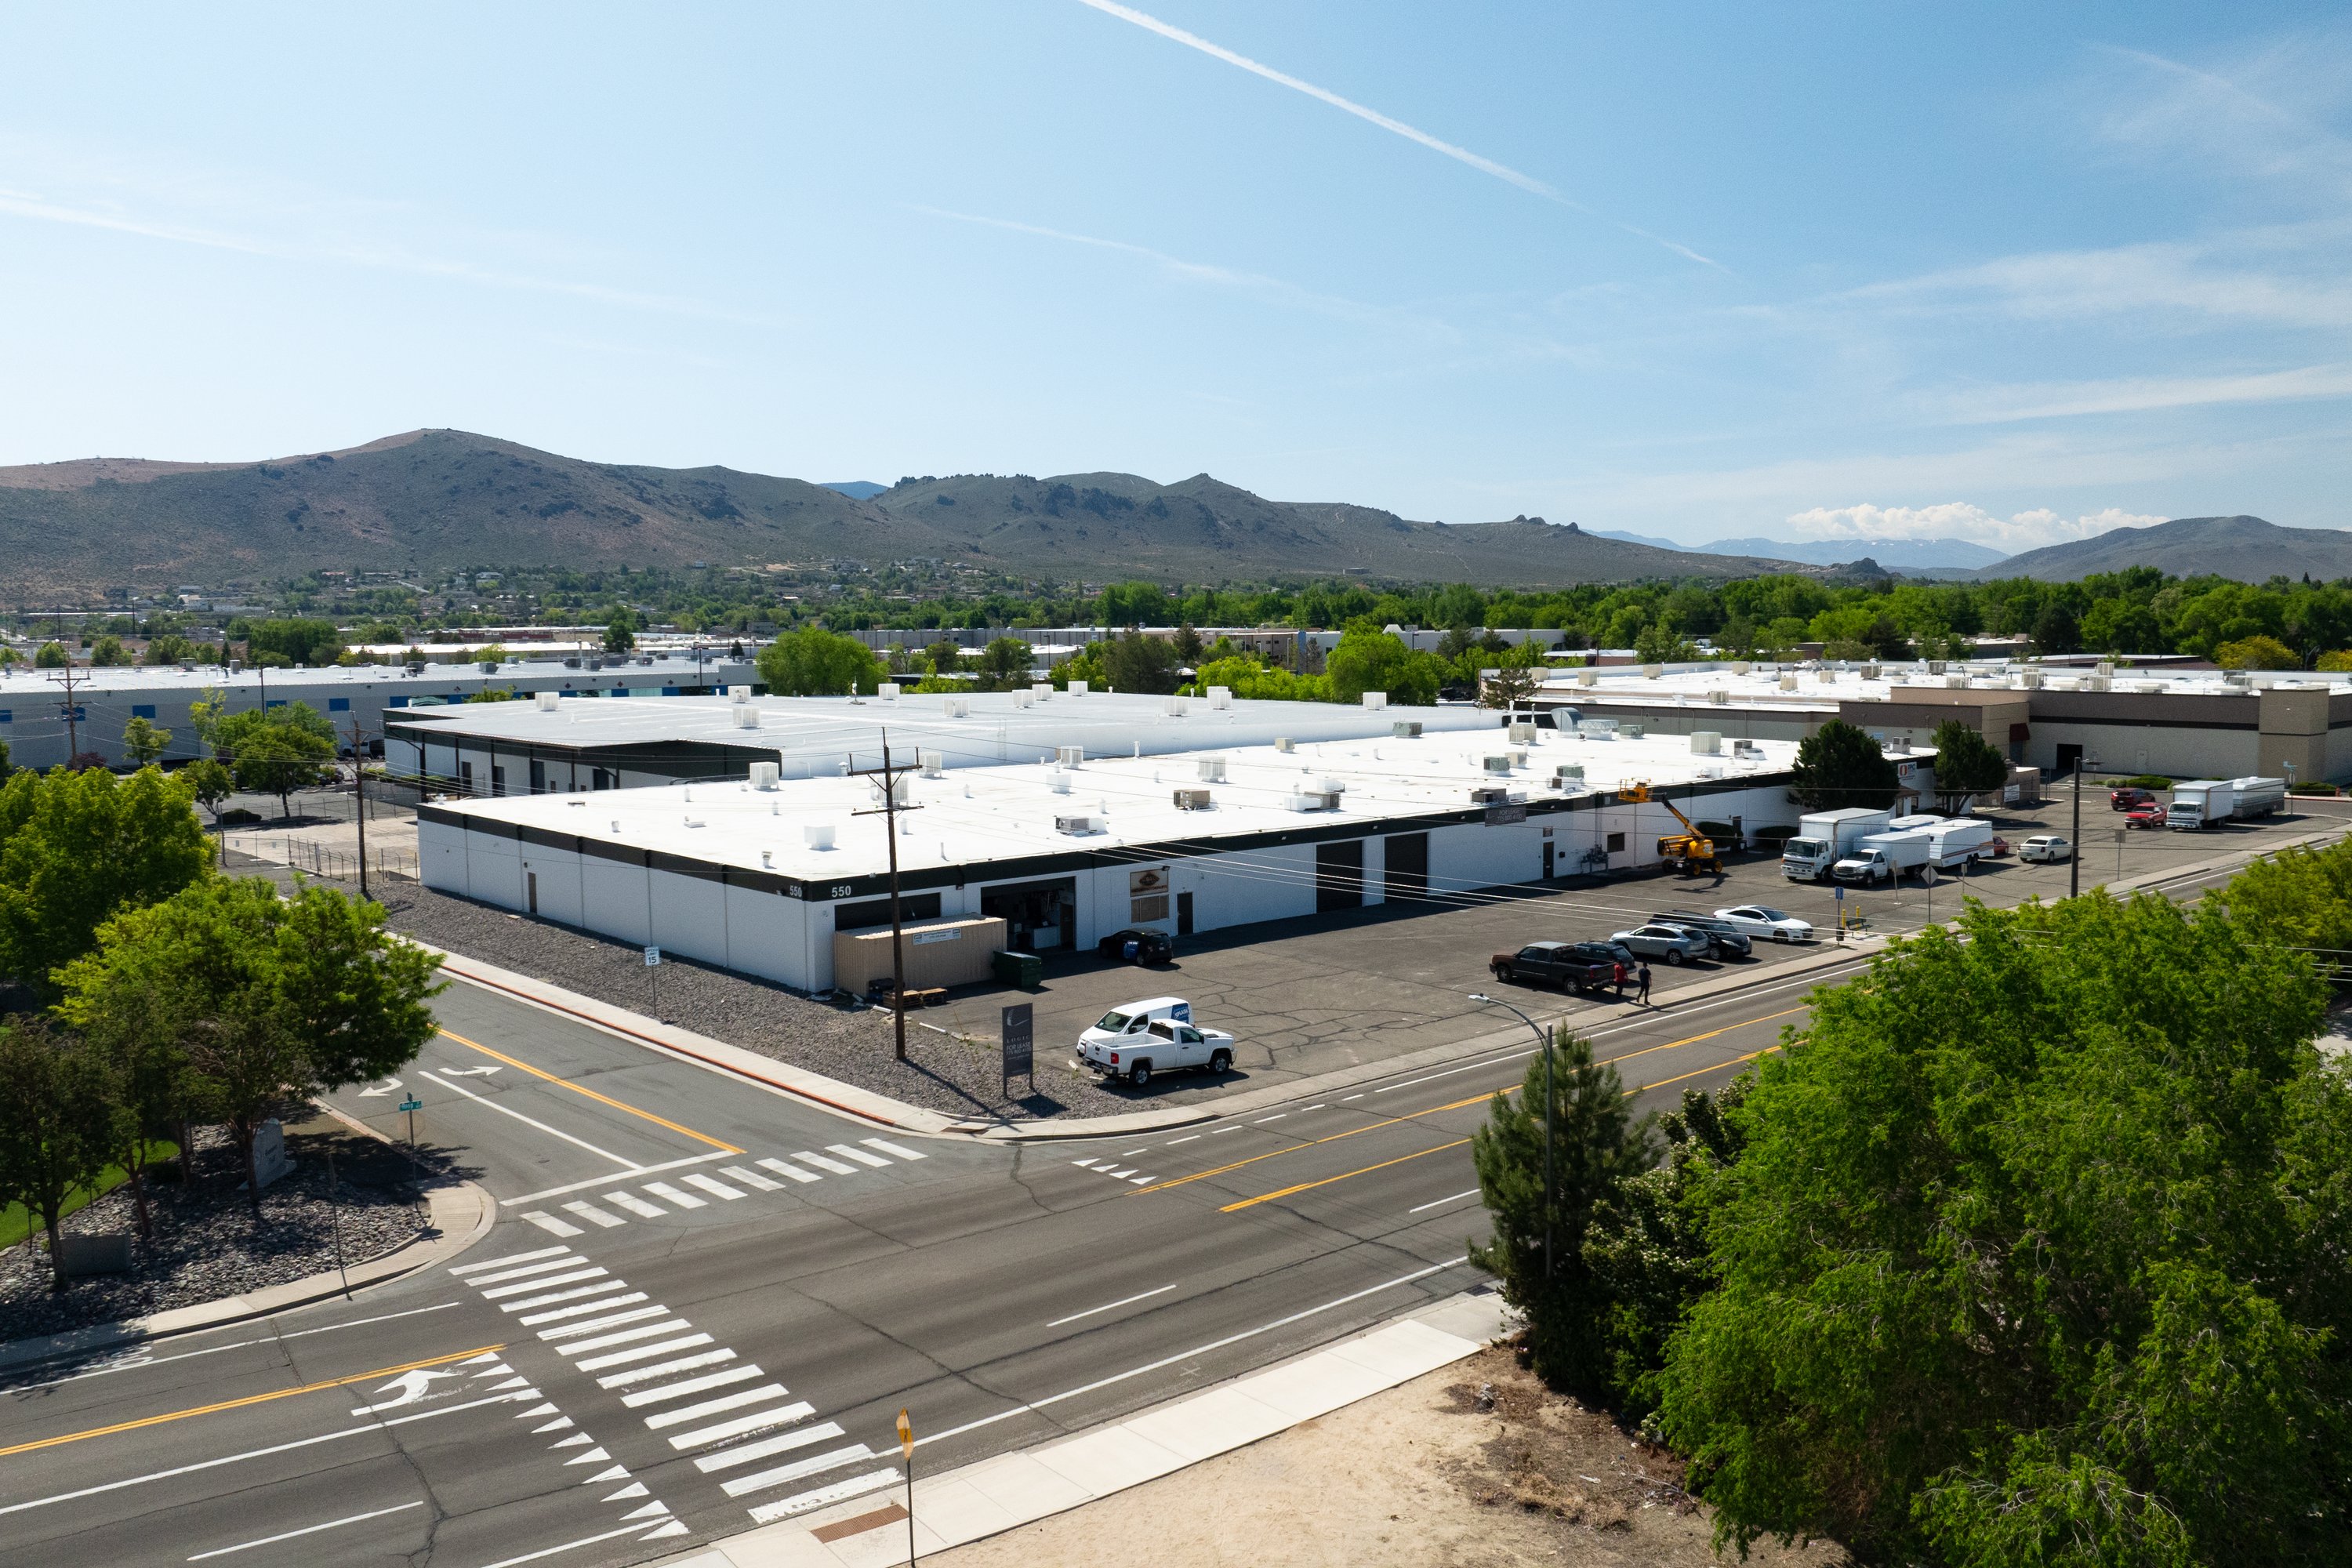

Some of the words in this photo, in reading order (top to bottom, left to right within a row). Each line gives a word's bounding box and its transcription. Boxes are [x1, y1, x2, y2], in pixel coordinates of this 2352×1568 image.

[789, 885, 802, 897] 550
[832, 885, 851, 898] 550
[1007, 1035, 1030, 1044] LOGIC
